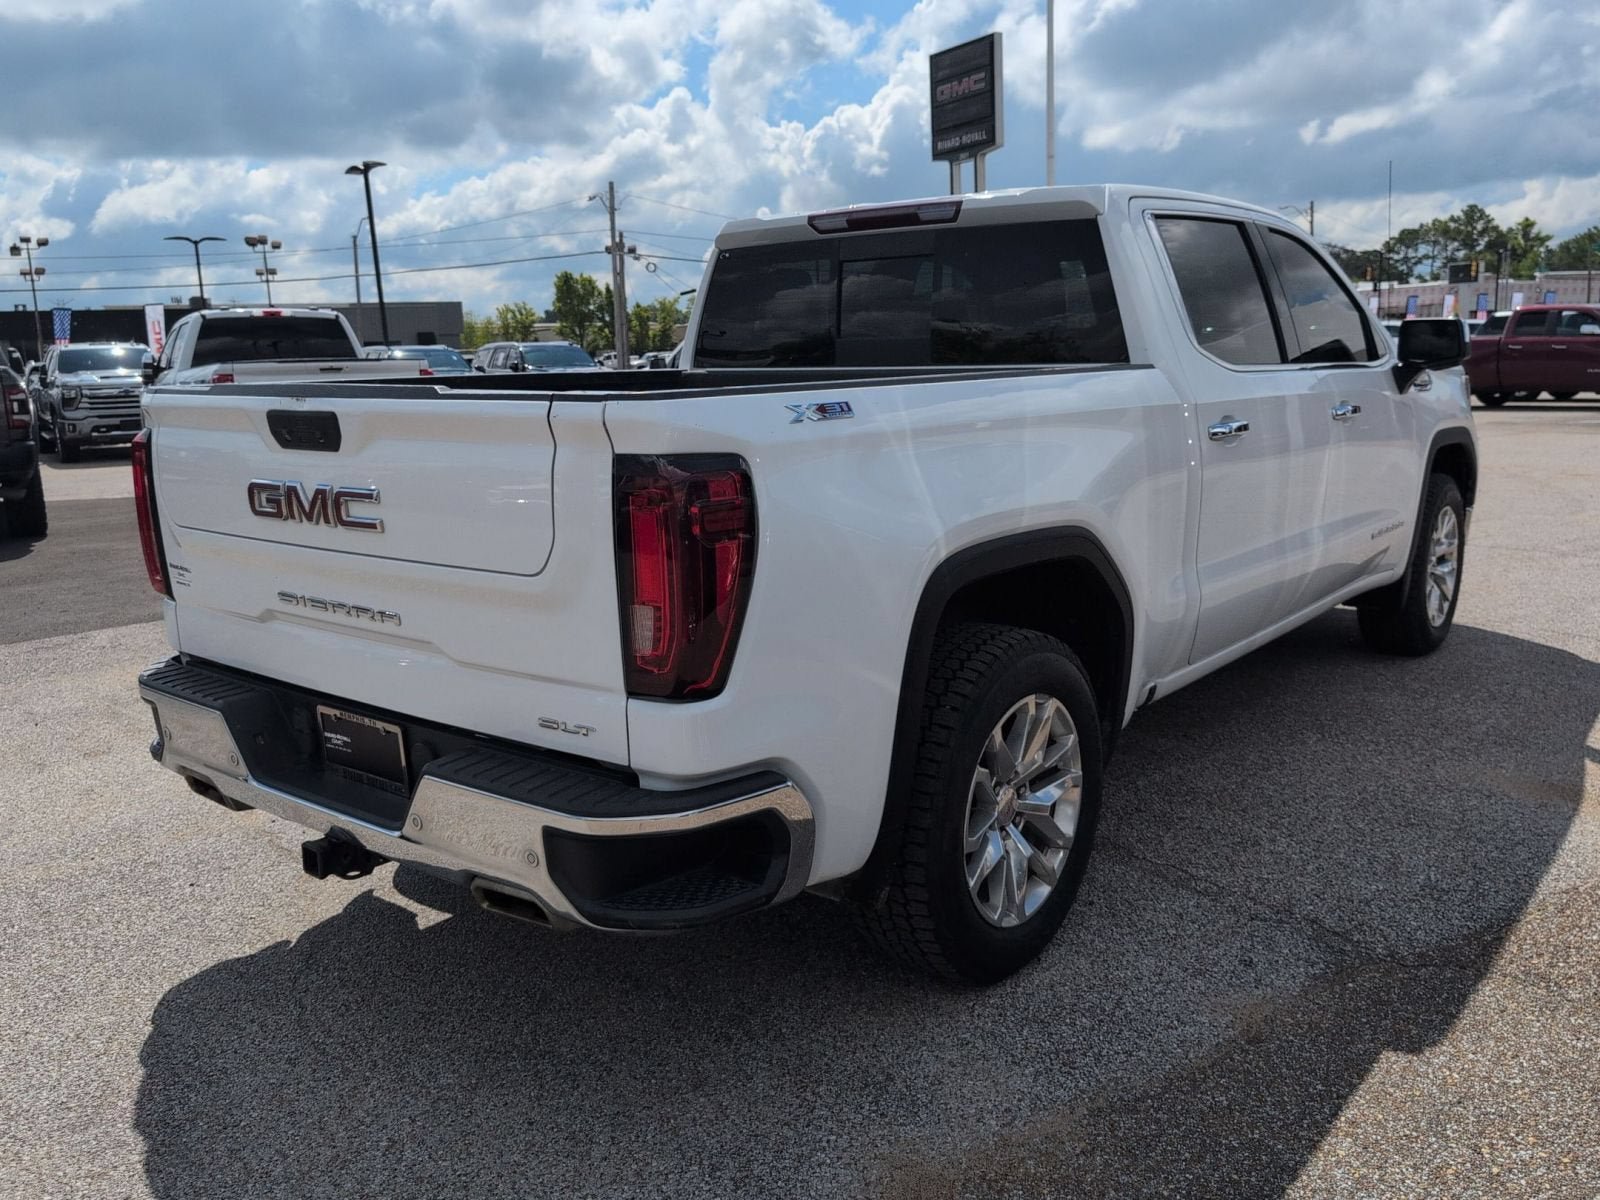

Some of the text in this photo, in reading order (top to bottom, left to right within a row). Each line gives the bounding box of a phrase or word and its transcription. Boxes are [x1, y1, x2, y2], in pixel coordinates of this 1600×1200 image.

[937, 72, 985, 100] GMC
[784, 402, 851, 424] X31
[247, 478, 384, 534] GMC
[277, 590, 402, 627] SIERRA
[538, 716, 597, 737] SLT
